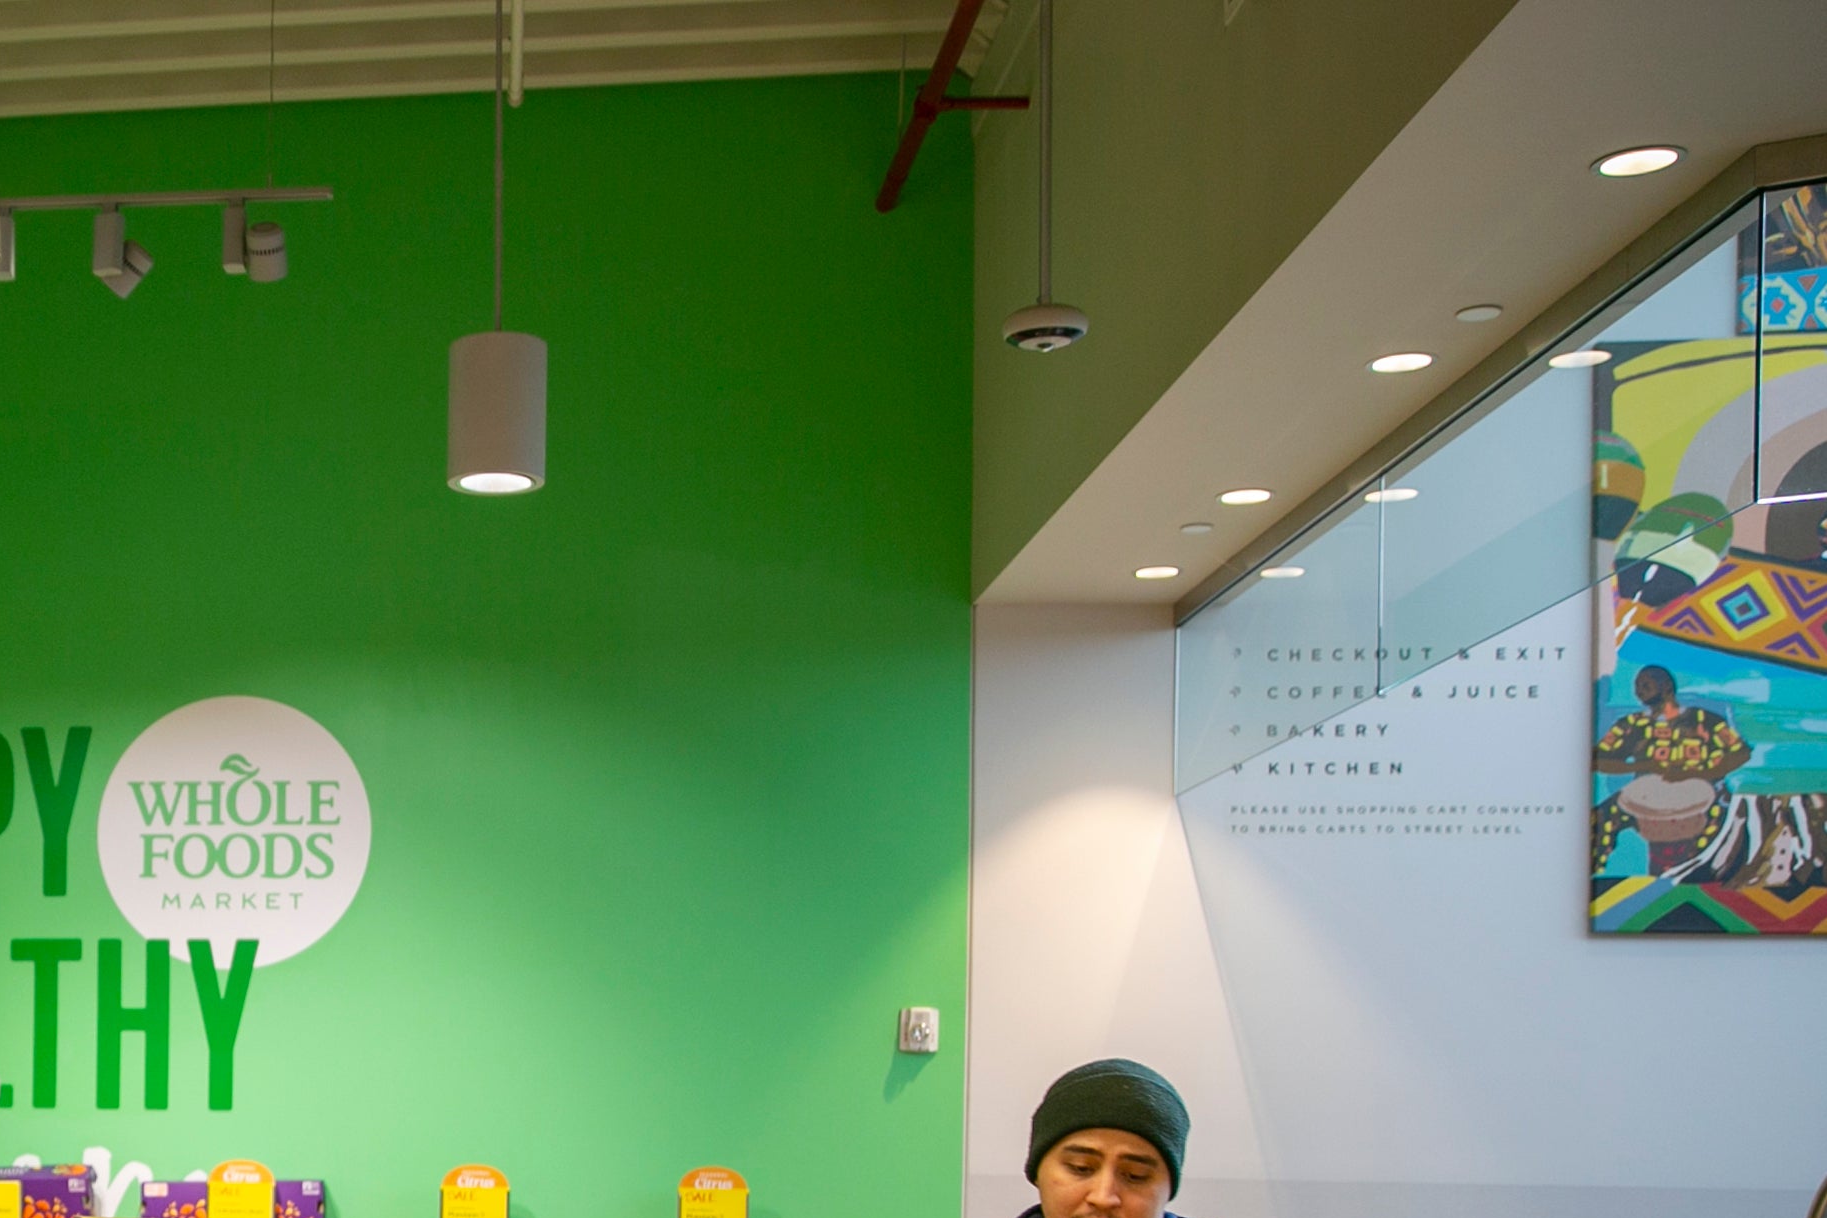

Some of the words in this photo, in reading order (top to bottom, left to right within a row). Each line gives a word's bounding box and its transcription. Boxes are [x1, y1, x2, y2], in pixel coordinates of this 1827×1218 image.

[1267, 647, 1433, 662] CHECKOUT
[1496, 647, 1565, 661] EXIT
[1267, 686, 1387, 700] COFFEE
[1412, 686, 1423, 699] &
[1448, 685, 1539, 699] JUICE
[1266, 724, 1388, 738] BAKERY
[1268, 762, 1403, 775] KITCHEN
[128, 770, 341, 827] WHOLE
[1230, 805, 1289, 815] PLEASE
[1298, 805, 1326, 815] USE
[1336, 805, 1418, 815] SHOPPING
[1426, 805, 1468, 815] CART
[1477, 805, 1566, 815] CONVEYOR
[1231, 824, 1249, 834] TO
[1258, 824, 1307, 834] BRING
[1316, 824, 1366, 834] CARTS
[1376, 824, 1395, 834] TO
[1404, 824, 1464, 834] STREET
[1473, 824, 1523, 834] LEVEL
[139, 832, 336, 881] FOODS
[161, 891, 305, 911] MARKET
